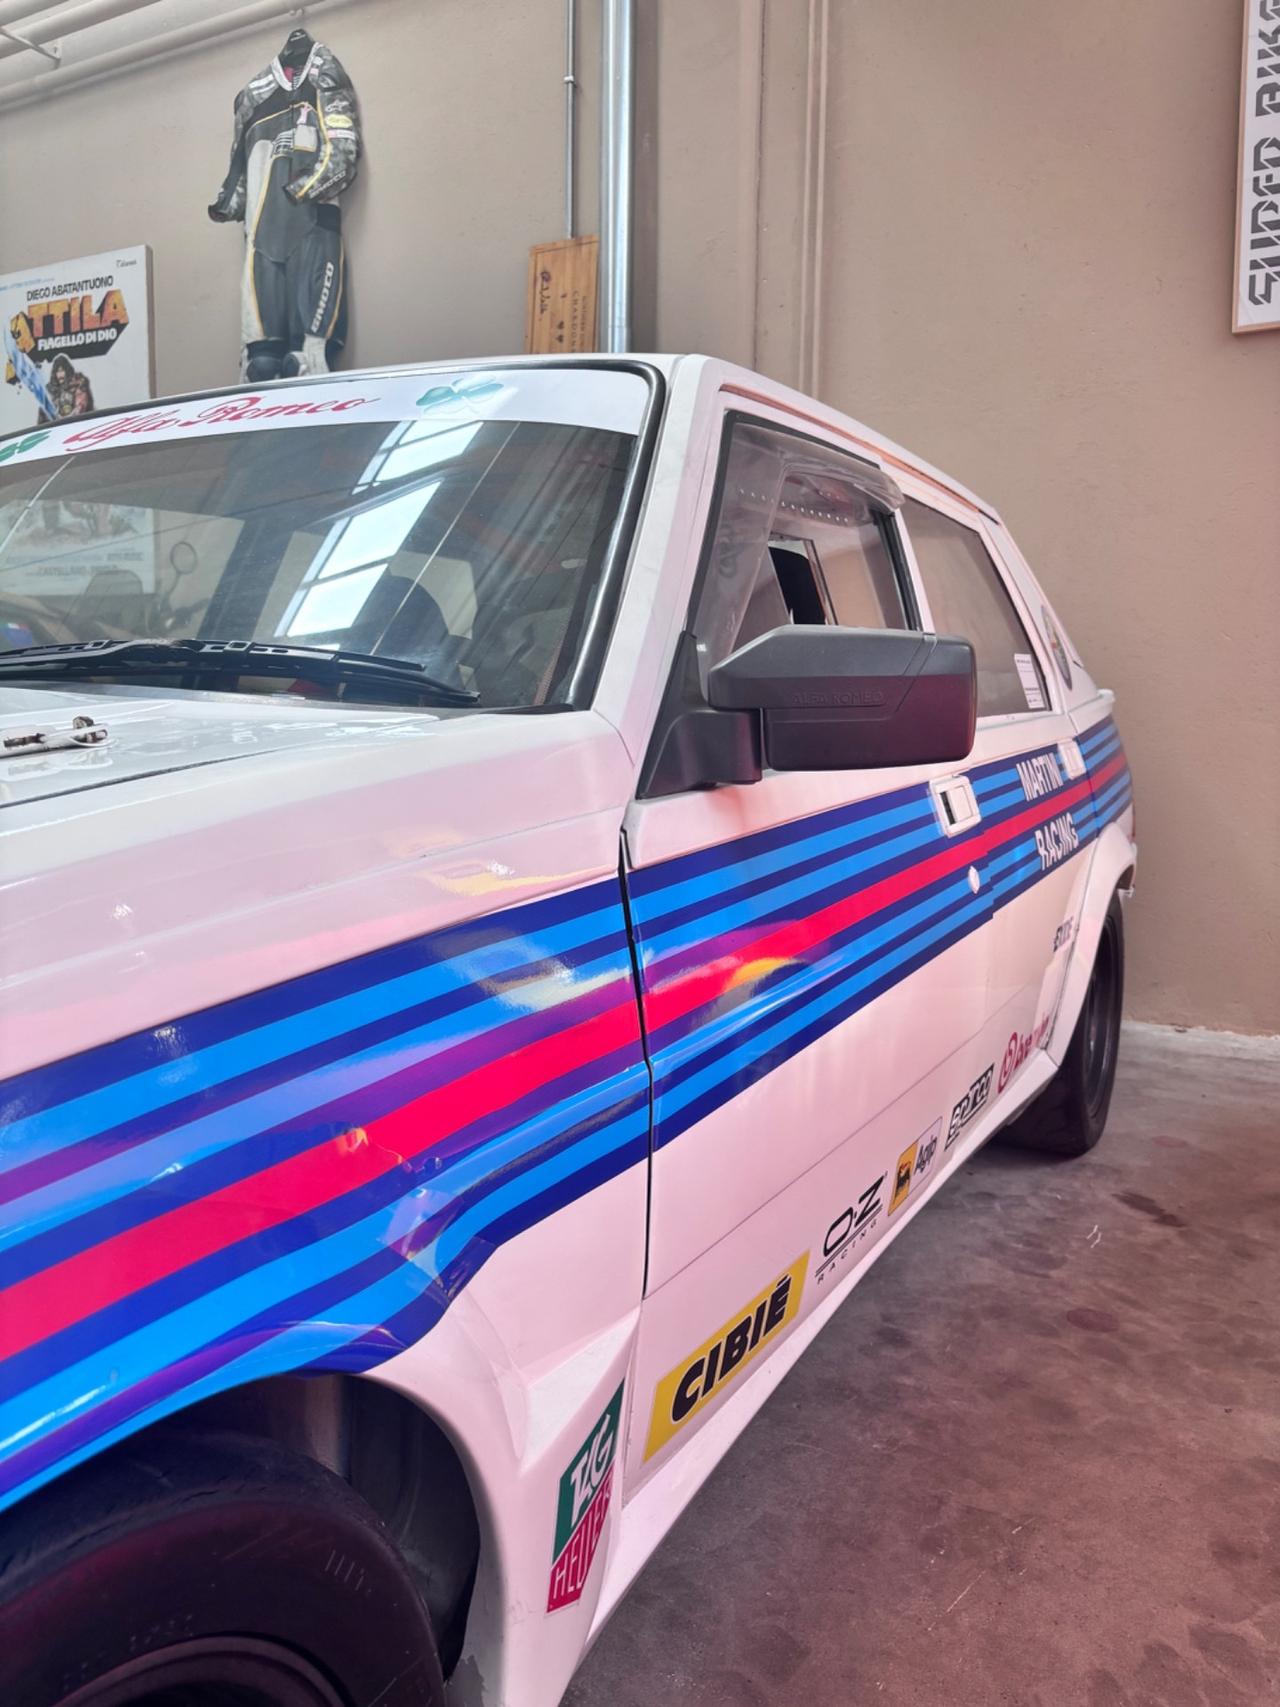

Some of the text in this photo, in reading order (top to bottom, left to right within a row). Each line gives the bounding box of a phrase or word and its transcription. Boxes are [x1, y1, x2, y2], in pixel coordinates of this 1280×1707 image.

[26, 287, 51, 302] DIEGO
[51, 275, 114, 297] ABATANTUONO
[10, 289, 129, 354] ATTILA
[37, 328, 118, 351] FLAGELLO DI DIO
[63, 396, 381, 452] Alfa Romeo
[1034, 812, 1079, 871] RACING
[816, 1218, 877, 1285] RACING
[671, 1273, 793, 1423] CIBIÉ
[570, 1413, 615, 1529] TAG
[552, 1464, 613, 1600] HEUER
